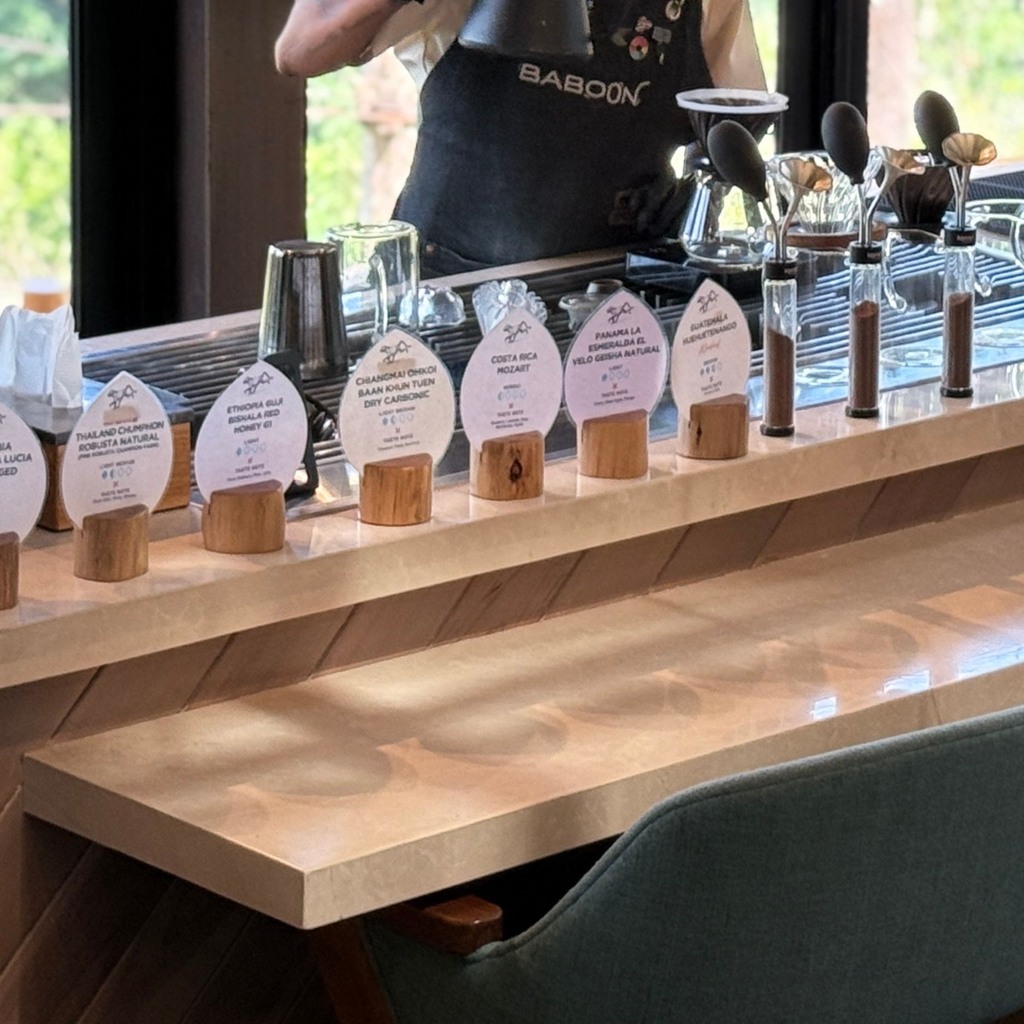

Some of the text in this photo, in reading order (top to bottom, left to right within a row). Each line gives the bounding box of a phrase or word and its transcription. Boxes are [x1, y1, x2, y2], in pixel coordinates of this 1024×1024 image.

[518, 62, 651, 107] BABOON
[690, 313, 728, 332] GUATEMALA
[595, 327, 641, 340] PANAMA LA
[588, 337, 646, 353] ESMERALDA EL
[491, 352, 538, 364] COSTA RICA
[572, 345, 660, 366] VELO GEISHA NATURAL
[497, 364, 531, 374] MOZART
[355, 370, 406, 386] CHIANGMAI
[358, 378, 436, 398] BAAN KHUN TUEN
[227, 397, 283, 414] ETHIOPIA GUJI
[364, 390, 430, 409] DRY CARBONIC
[264, 409, 280, 418] RED
[76, 427, 117, 442] THAILAND
[117, 421, 164, 434] CHUMPHON
[234, 422, 262, 434] HONEY
[78, 433, 159, 452] ROBUSTA NATURAL
[4, 453, 32, 464] LUCIA
